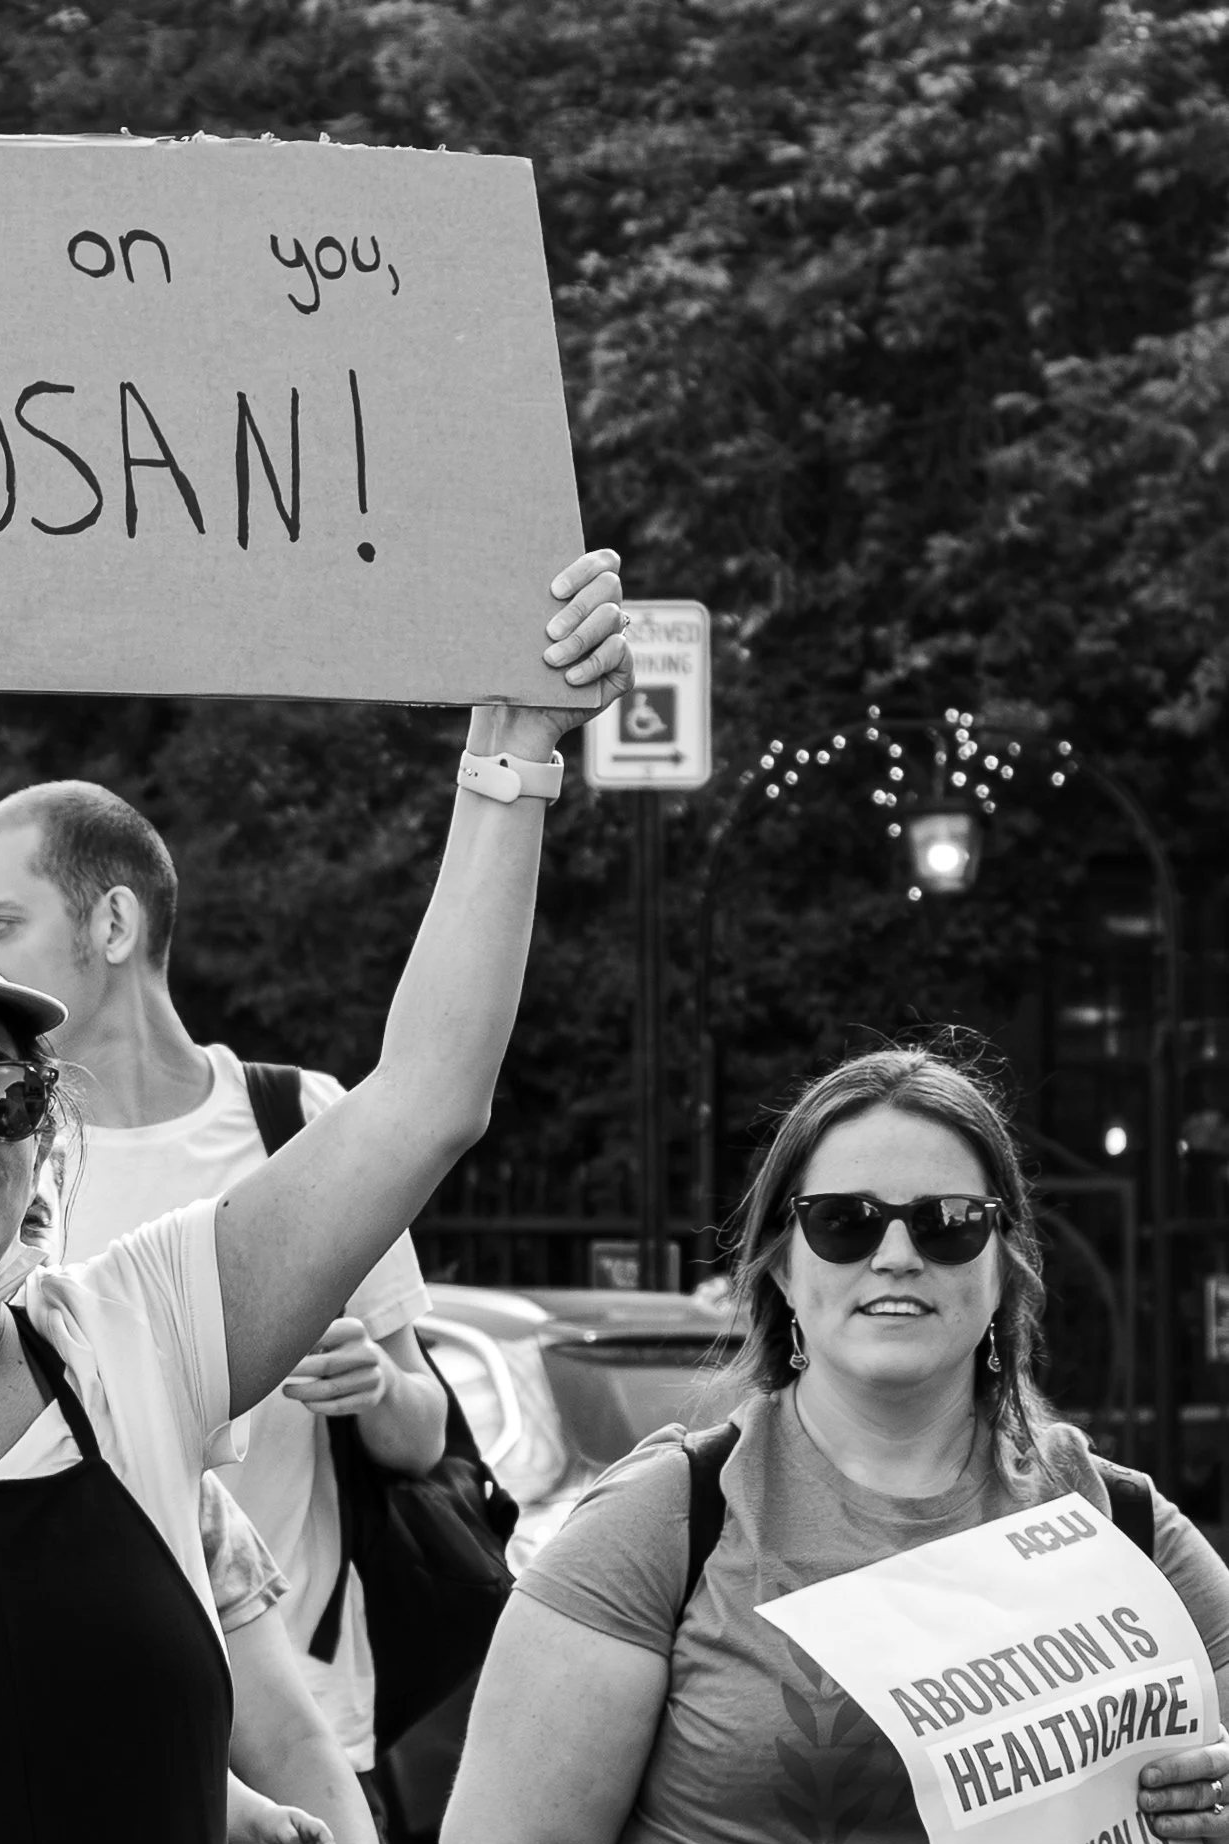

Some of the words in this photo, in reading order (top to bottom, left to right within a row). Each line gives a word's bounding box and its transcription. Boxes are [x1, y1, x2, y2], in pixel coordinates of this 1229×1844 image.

[68, 229, 170, 283] on
[271, 234, 400, 314] you,
[627, 622, 701, 643] SERVED
[635, 652, 694, 674] RKING
[1005, 1510, 1097, 1560] ACLU
[889, 1622, 1115, 1737] ABORTION
[1096, 1607, 1158, 1663] IS
[944, 1675, 1198, 1812] HEALTHCARE.
